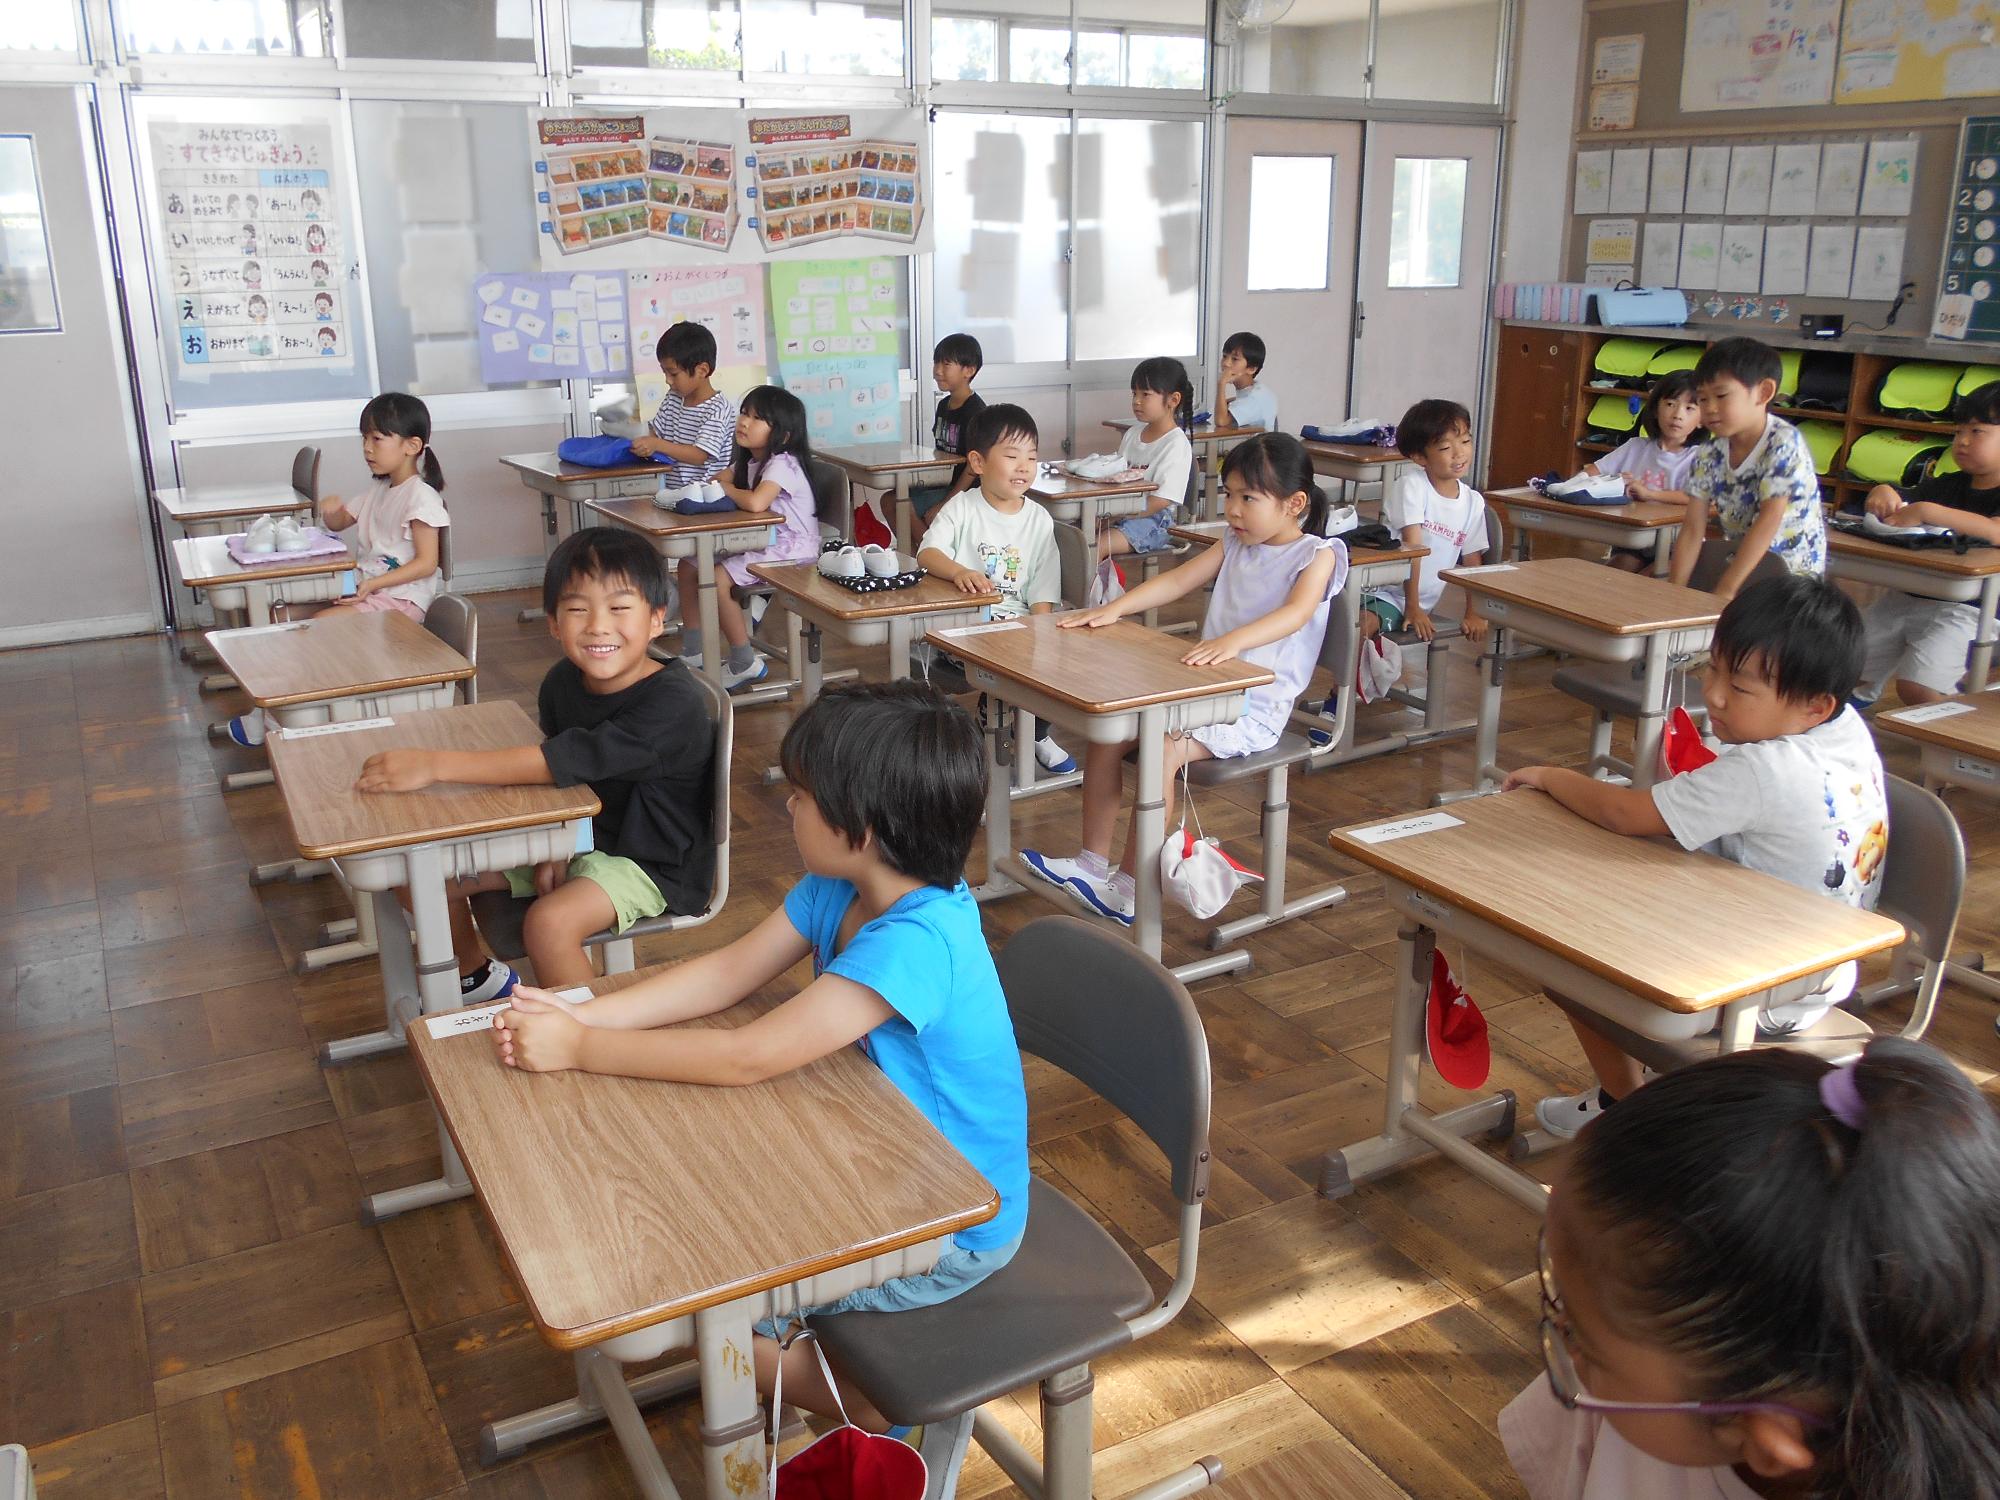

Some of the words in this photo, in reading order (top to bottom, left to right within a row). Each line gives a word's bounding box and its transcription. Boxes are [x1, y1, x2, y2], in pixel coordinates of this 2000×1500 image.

[799, 118, 849, 131] たんけんマップ
[199, 129, 280, 142] みんなでつくろう
[179, 144, 303, 164] すてきなじゅぎょう
[1968, 160, 1976, 177] 1
[203, 174, 239, 184] ききかた
[274, 173, 309, 184] はんのう
[168, 193, 184, 215] あ
[1958, 188, 1972, 206] 2
[1956, 216, 1969, 234] 3
[172, 232, 189, 249] い
[1951, 249, 1965, 264] 4
[180, 265, 191, 287] う
[202, 269, 241, 282] うなずいて
[1946, 275, 1959, 291] 5
[183, 300, 198, 321] え
[207, 303, 241, 316] えがおで
[186, 334, 203, 355] お
[210, 337, 246, 350] おわりまで
